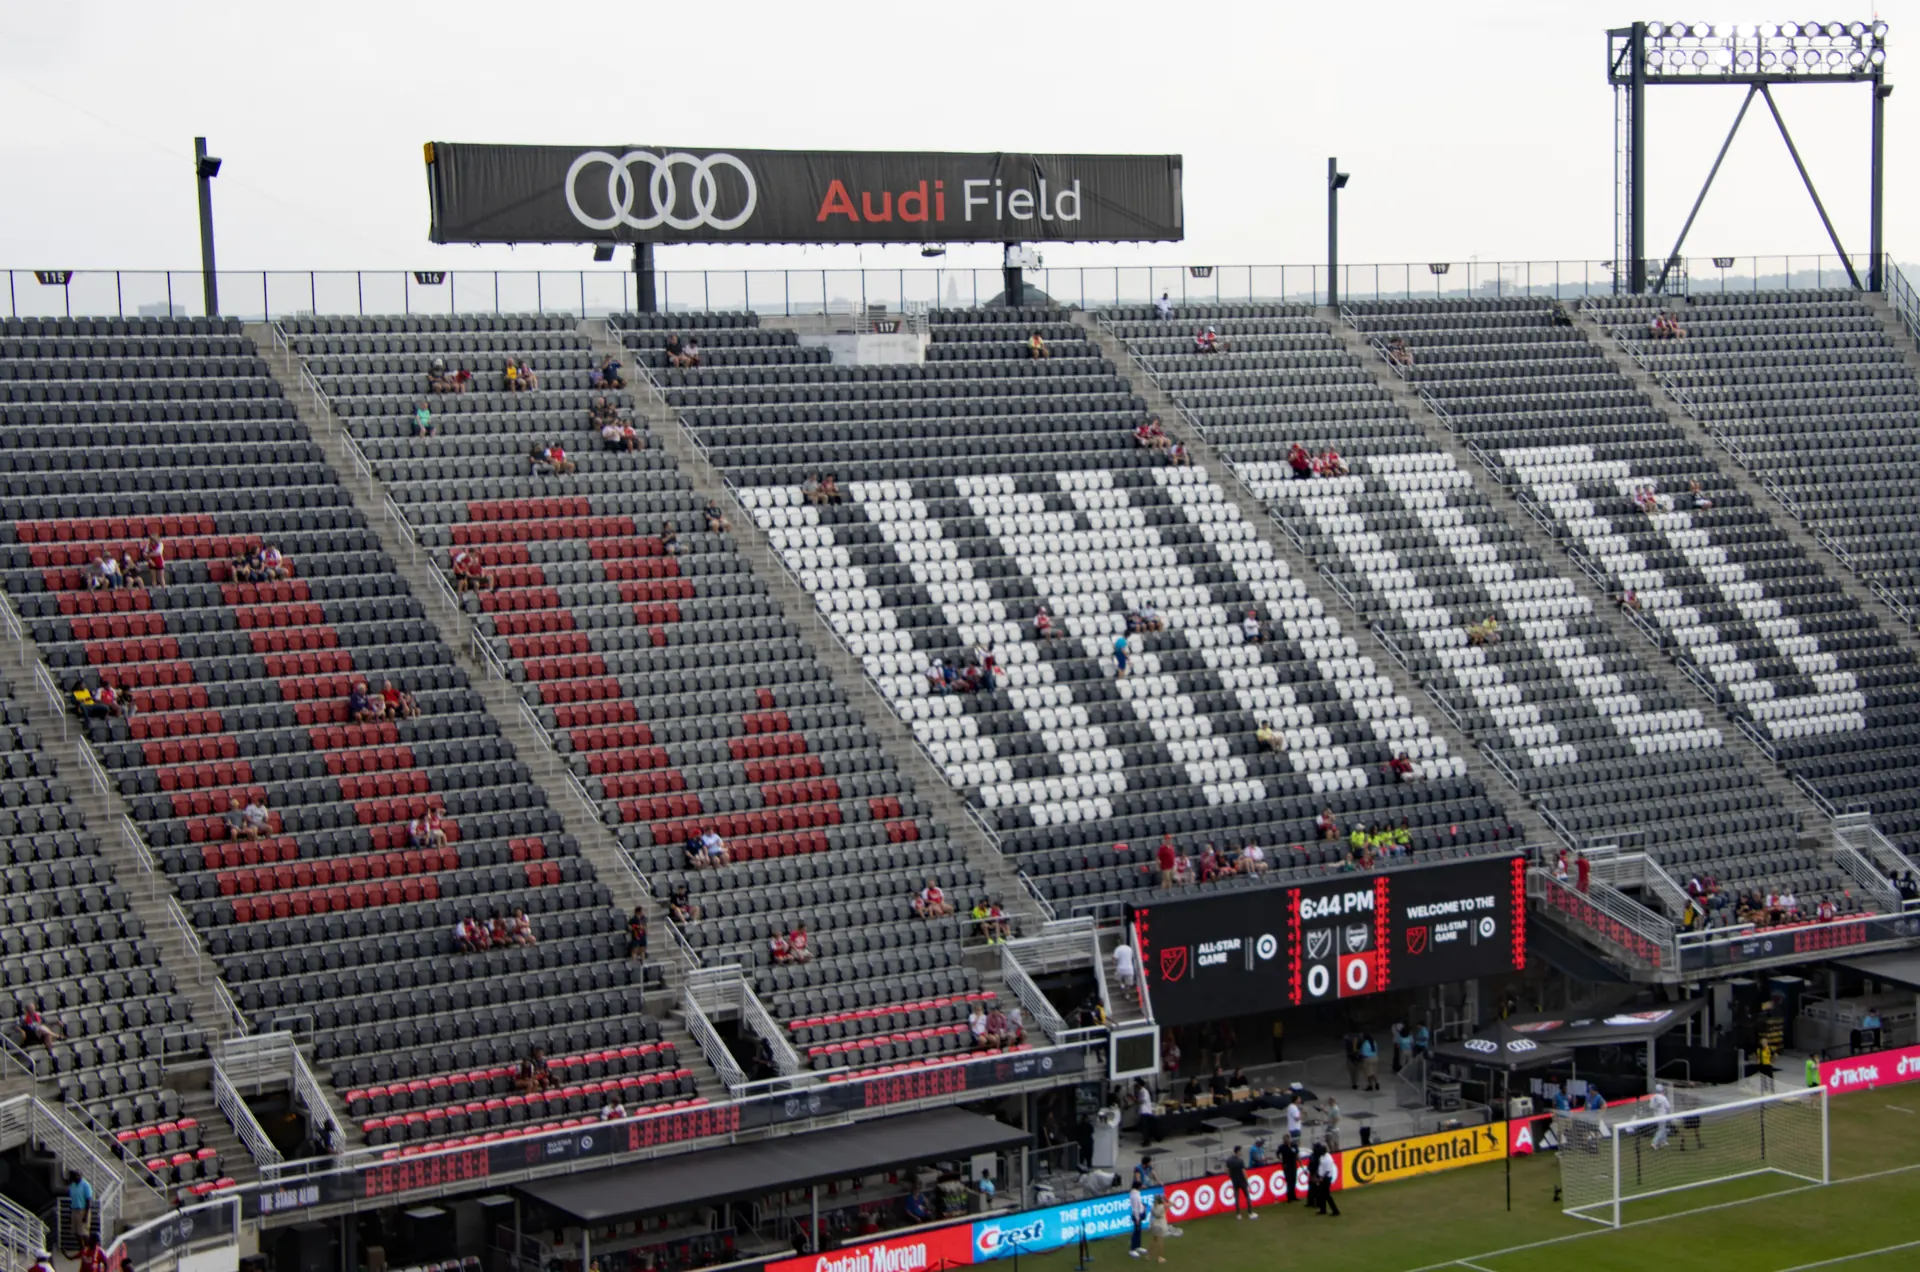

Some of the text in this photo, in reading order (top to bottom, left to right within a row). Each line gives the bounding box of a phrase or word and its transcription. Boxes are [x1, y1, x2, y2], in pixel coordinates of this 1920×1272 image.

[816, 179, 1082, 222] Audi Field
[43, 271, 66, 284] 115
[421, 272, 440, 284] 116
[879, 322, 896, 333] 117
[1300, 889, 1374, 920] 6:44 PM
[1406, 895, 1496, 920] WELCOME TO THE
[1435, 919, 1468, 933] ALL-STAR
[1435, 931, 1458, 943] GAME
[1198, 938, 1242, 955] ALL-STAR
[1198, 952, 1228, 967] GAME
[1307, 964, 1330, 997] 0
[1346, 958, 1369, 991] 0
[1842, 1065, 1879, 1085] TikTok
[1351, 1129, 1480, 1184] Continental
[1060, 1208, 1079, 1222] THE
[1097, 1219, 1109, 1233] IN
[978, 1220, 1043, 1251] Crest
[815, 1243, 927, 1272] Captain Morgan
